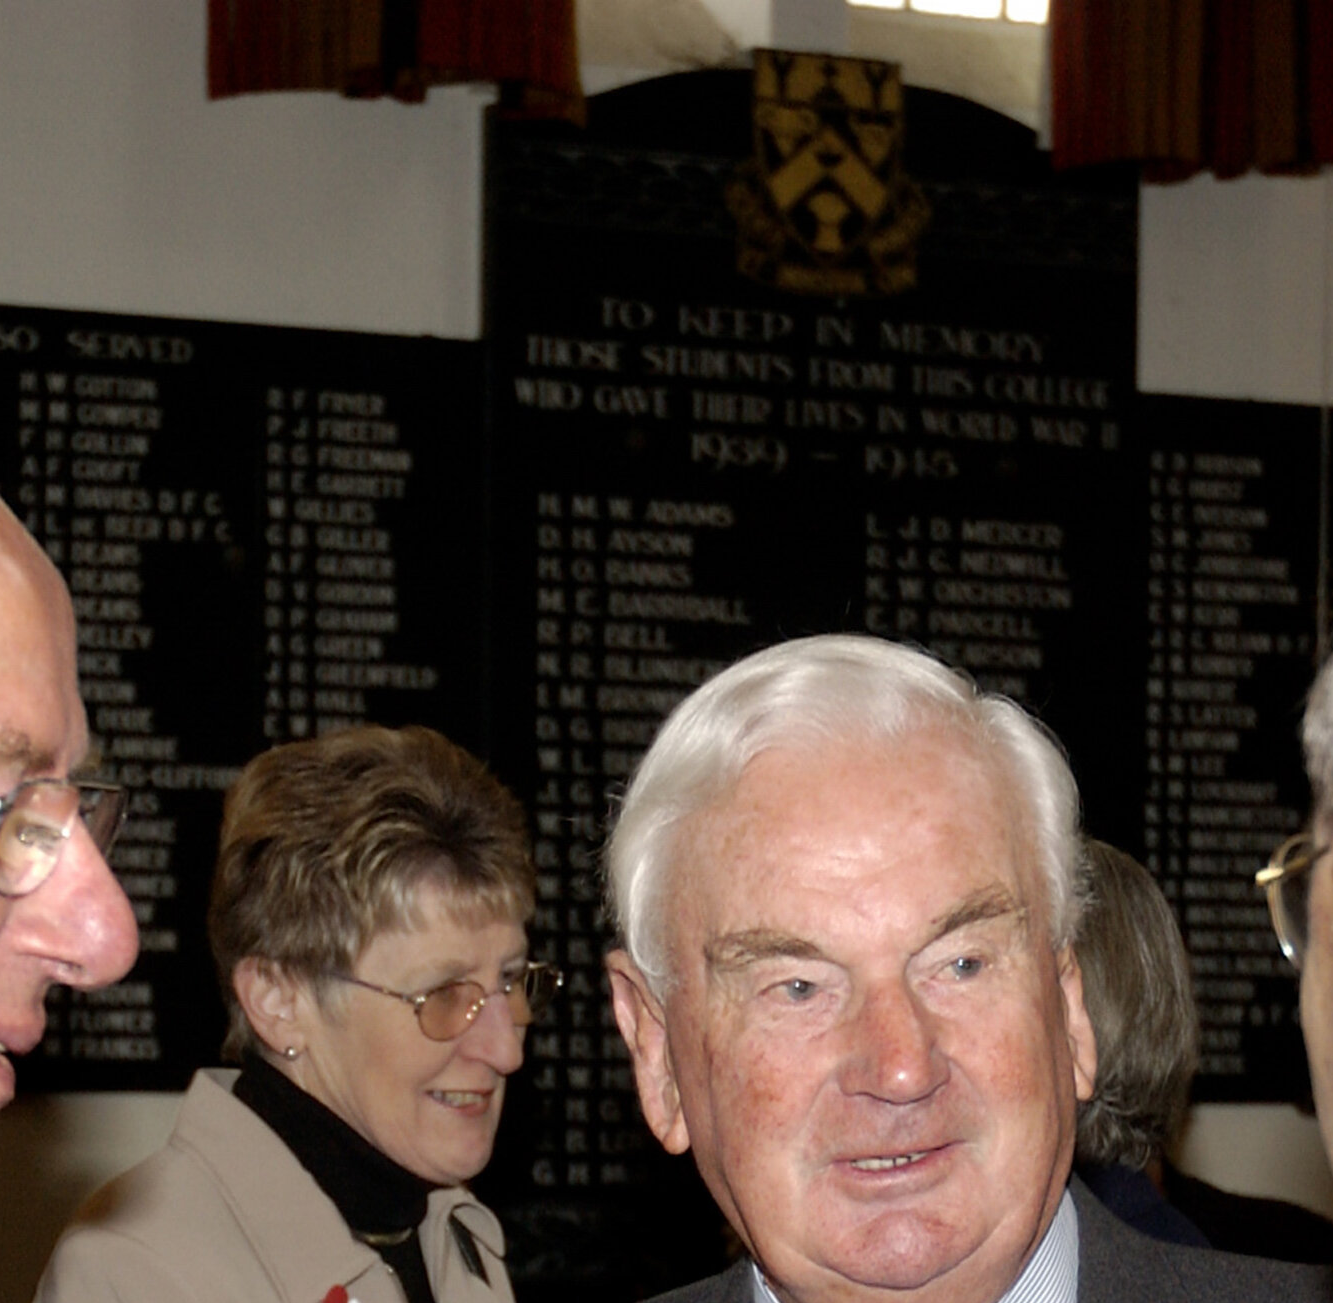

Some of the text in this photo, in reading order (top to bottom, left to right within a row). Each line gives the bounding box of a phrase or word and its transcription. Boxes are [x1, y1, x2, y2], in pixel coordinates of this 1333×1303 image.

[67, 331, 193, 363] SERVED
[602, 297, 1042, 366] TO KEEP IN MEMORY
[526, 335, 624, 371] THOSE
[642, 346, 794, 381] STUDENTS
[810, 358, 894, 390] FROM
[984, 375, 1108, 409] COLLEGE
[515, 378, 582, 408] WHO
[593, 386, 666, 418] GAVE
[693, 391, 771, 423] THEIR
[785, 400, 865, 429] LIVES
[878, 405, 906, 432] IN
[921, 409, 1017, 441] WORLD
[1031, 417, 1087, 447] WAR
[691, 433, 787, 470] 1939
[865, 446, 958, 478] 1945
